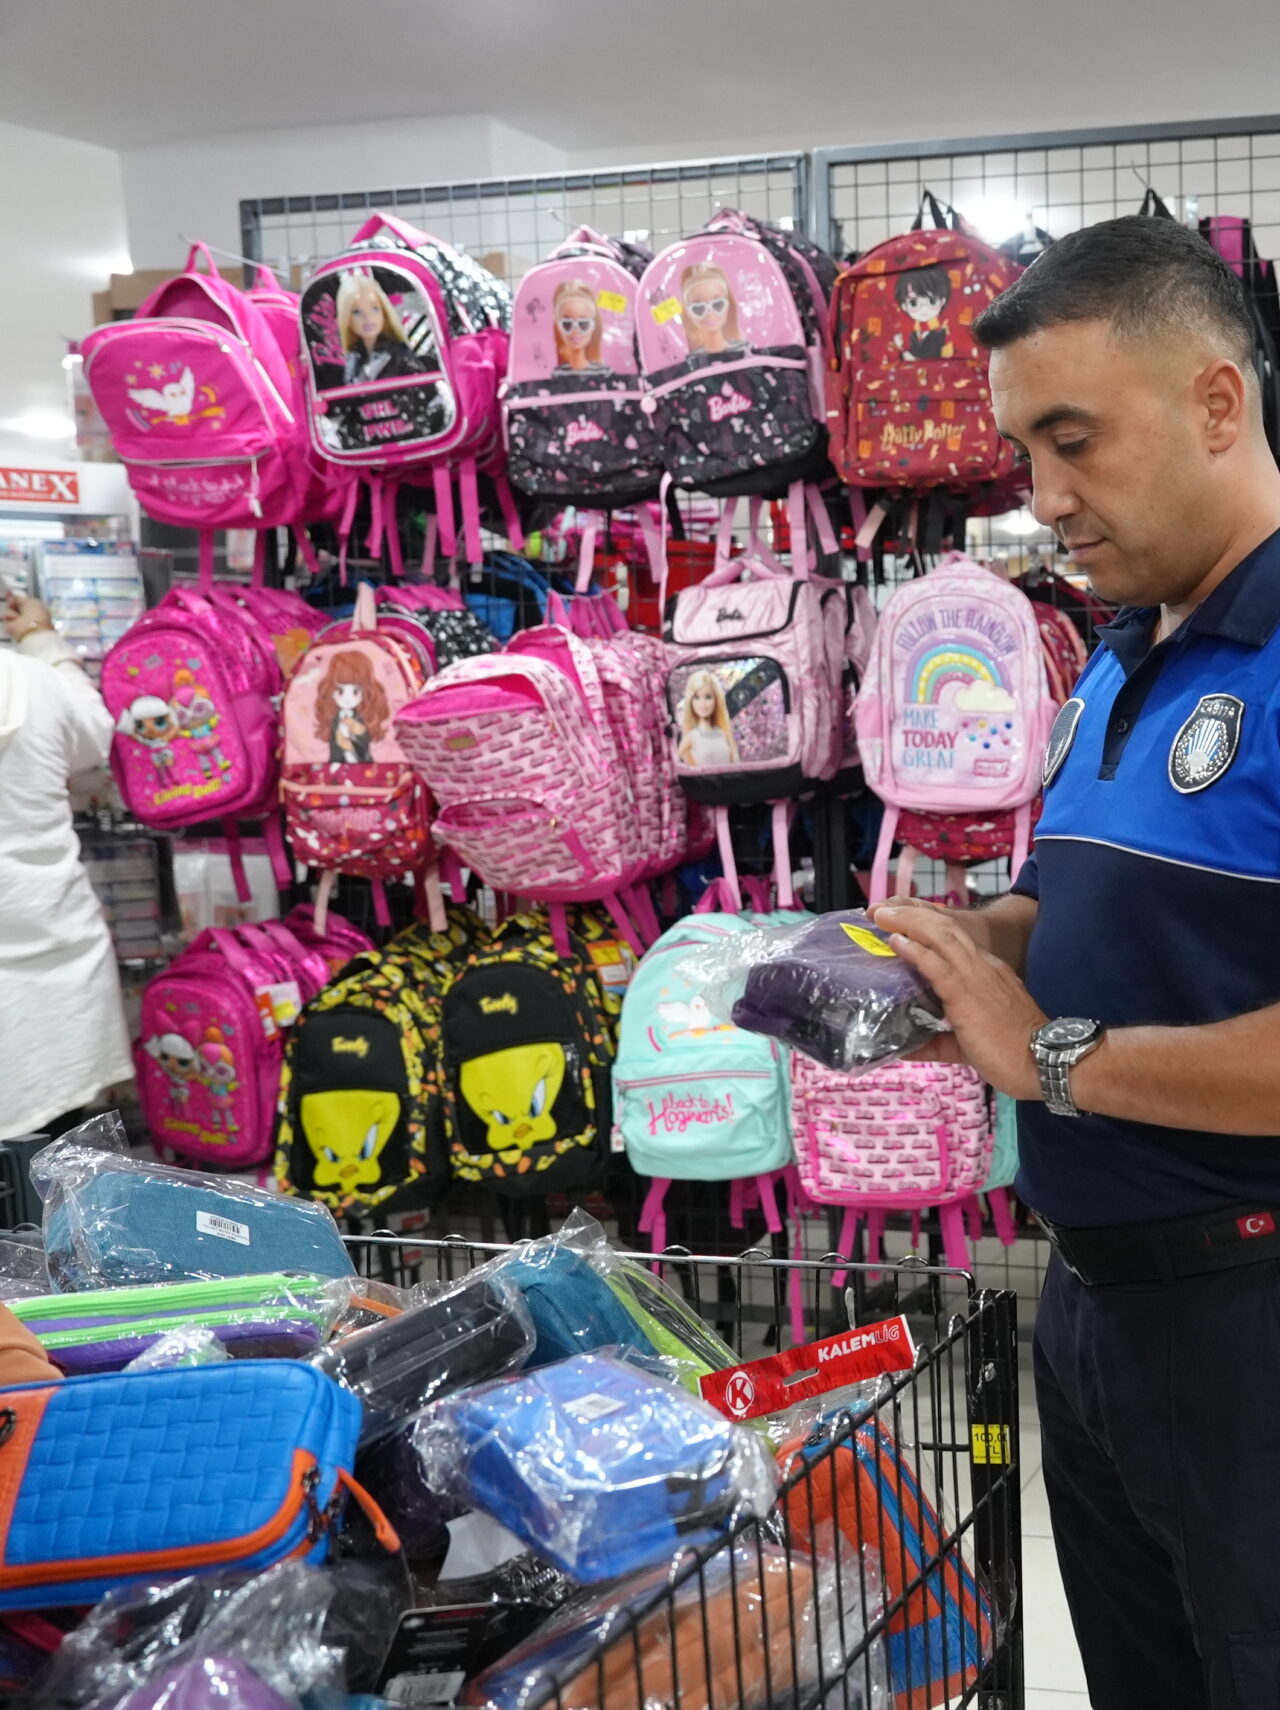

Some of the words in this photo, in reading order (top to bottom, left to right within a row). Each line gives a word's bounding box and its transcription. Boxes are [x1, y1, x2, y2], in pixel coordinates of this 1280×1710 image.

[707, 391, 752, 422] Barbie
[896, 611, 937, 651] FOLLOW
[939, 608, 963, 629] THE
[904, 708, 939, 729] MAKE
[902, 730, 958, 749] TODAY
[902, 750, 955, 769] GREAT
